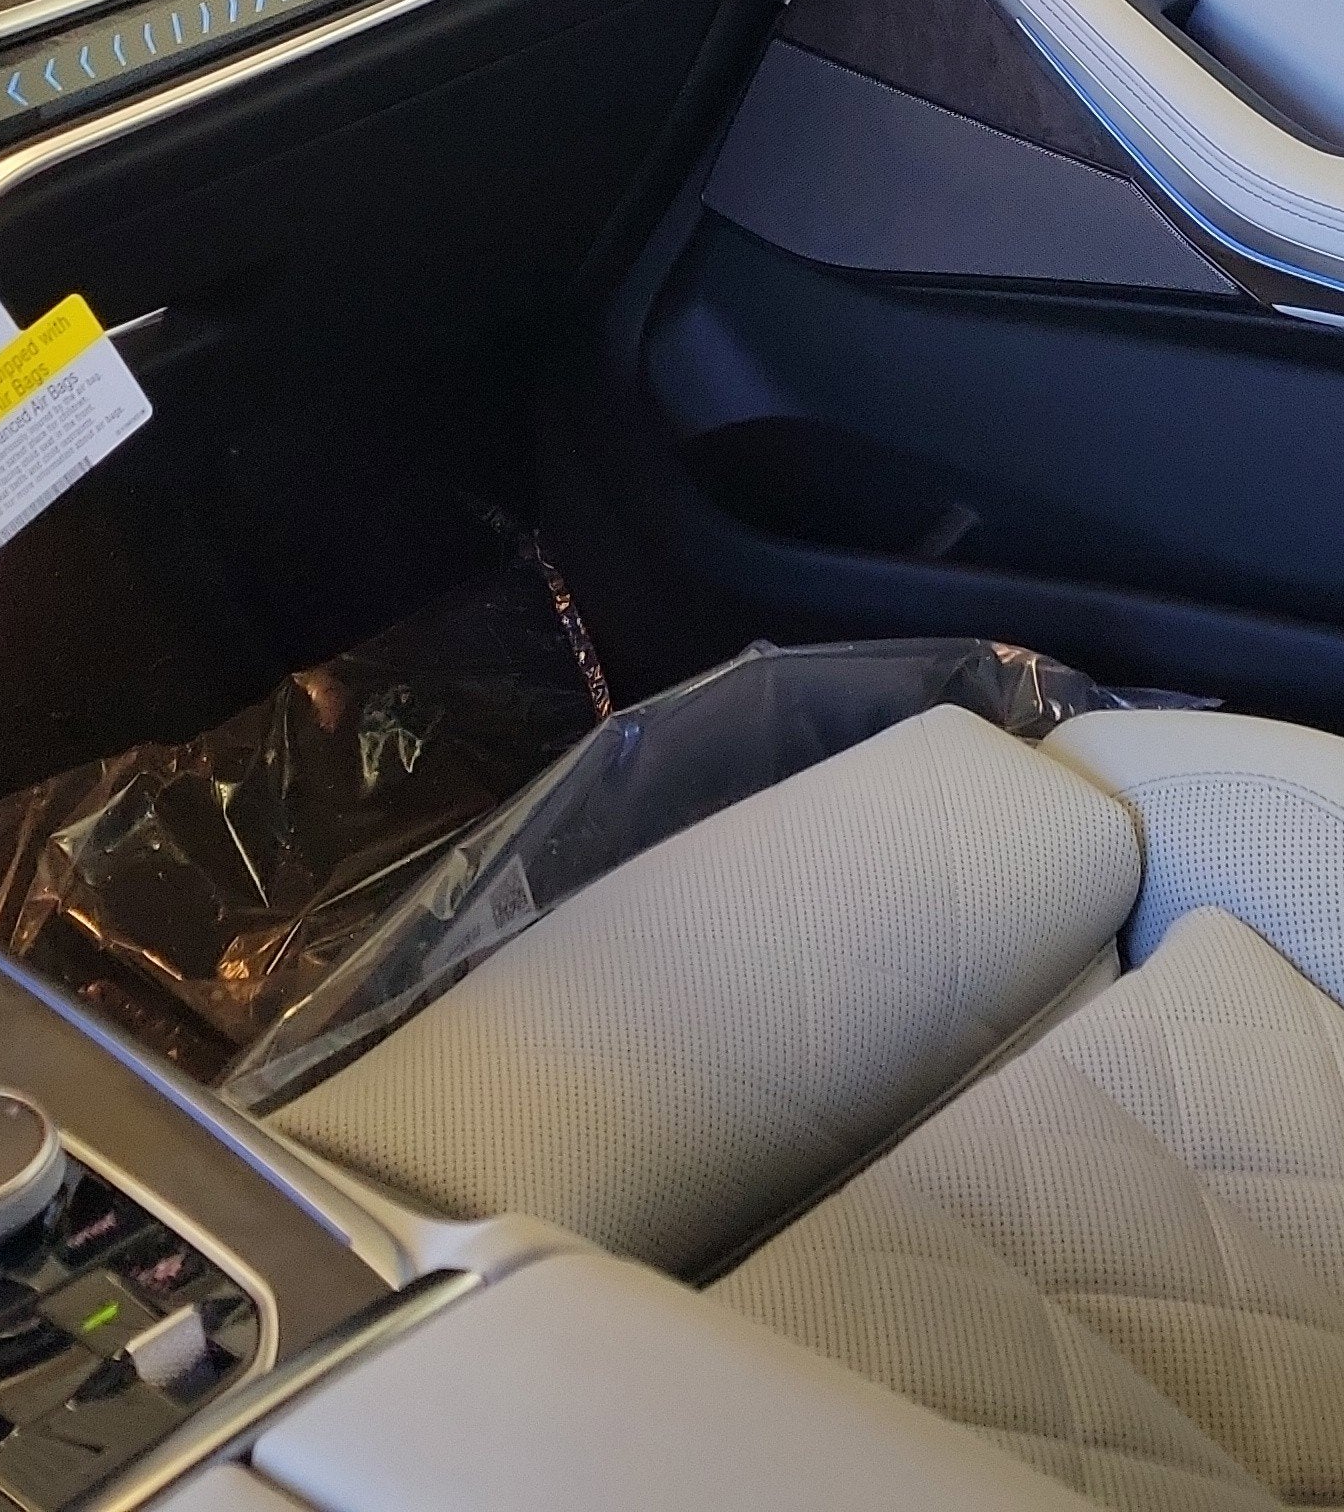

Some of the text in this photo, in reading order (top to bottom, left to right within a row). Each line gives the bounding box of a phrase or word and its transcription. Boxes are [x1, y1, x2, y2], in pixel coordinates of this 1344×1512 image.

[40, 314, 72, 346] with
[10, 362, 51, 397] Bags
[31, 394, 49, 416] Air
[47, 372, 79, 401] Bags
